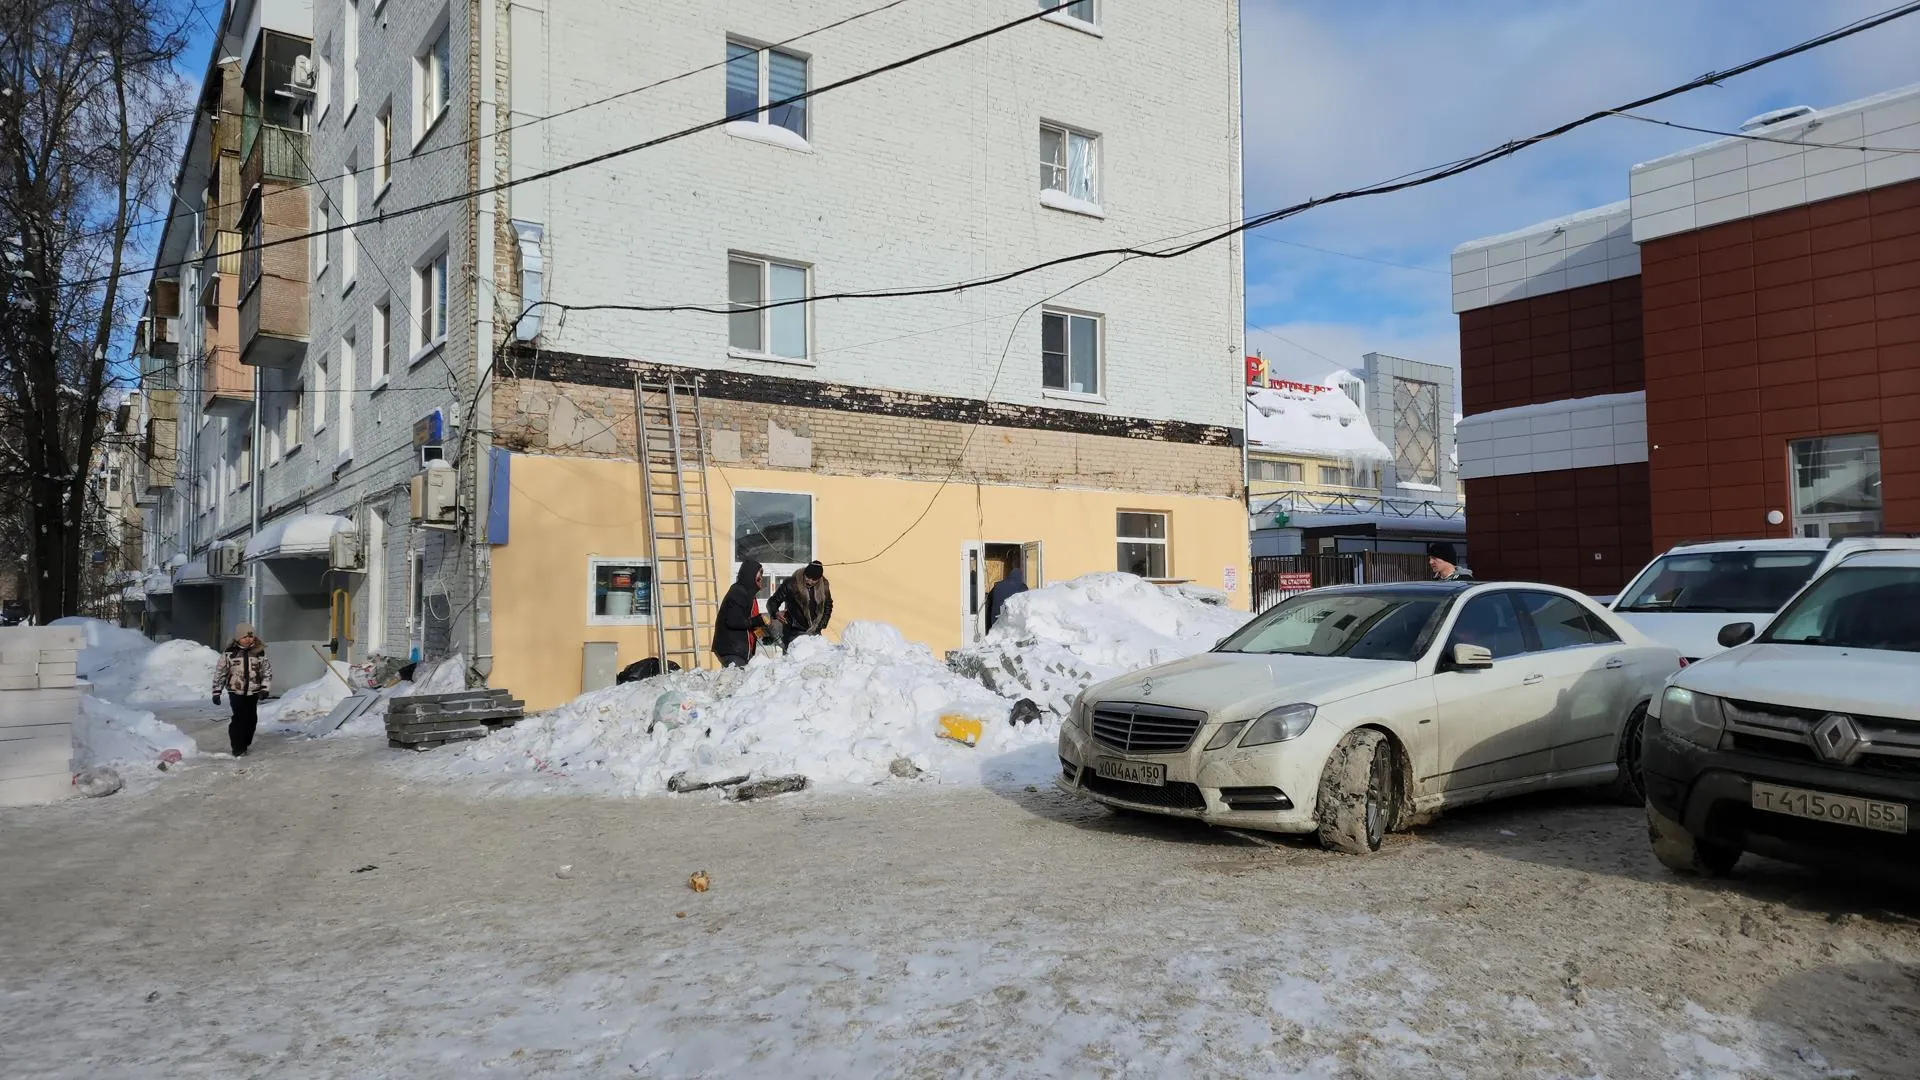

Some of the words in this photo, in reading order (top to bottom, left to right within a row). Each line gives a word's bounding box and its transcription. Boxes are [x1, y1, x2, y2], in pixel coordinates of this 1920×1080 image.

[1141, 765, 1159, 779] 150
[1762, 791, 1862, 824] Т415ОА
[1869, 803, 1897, 822] 55
